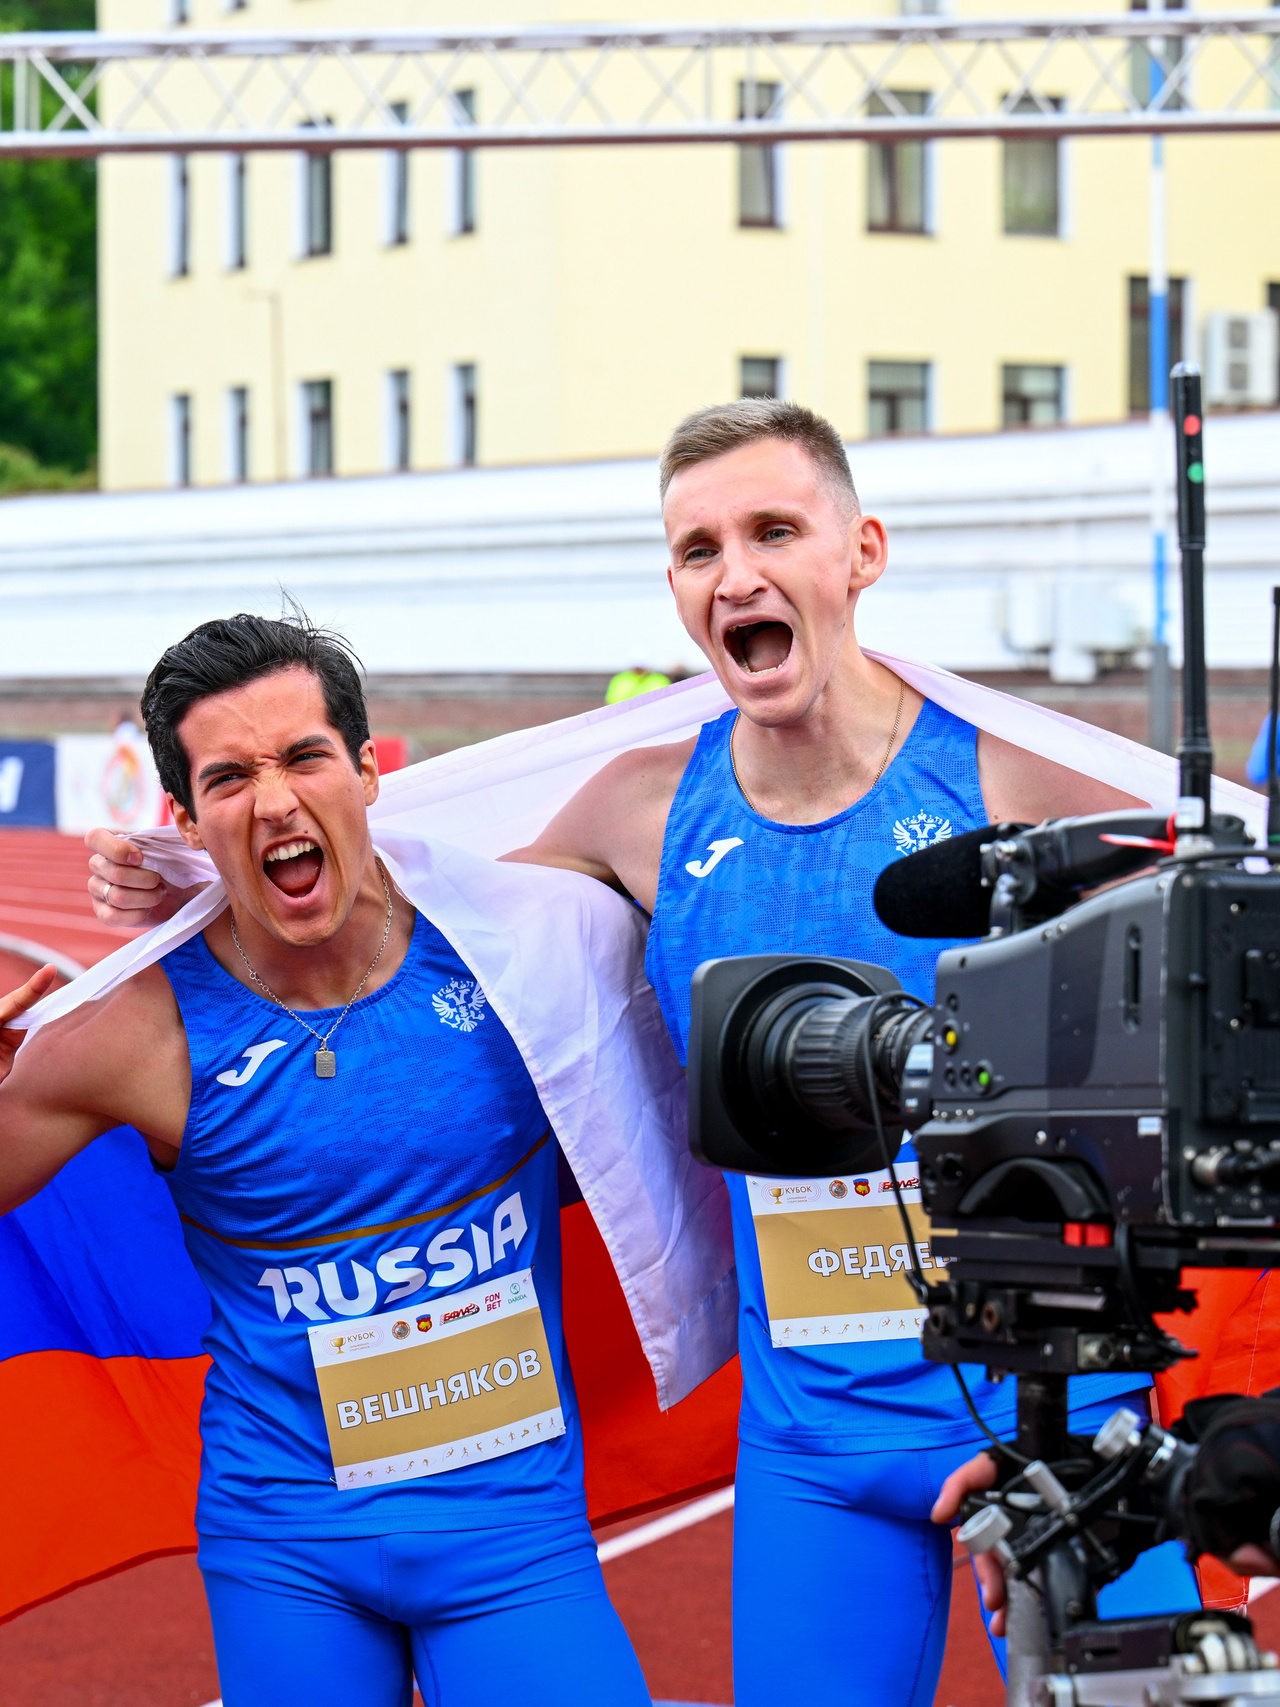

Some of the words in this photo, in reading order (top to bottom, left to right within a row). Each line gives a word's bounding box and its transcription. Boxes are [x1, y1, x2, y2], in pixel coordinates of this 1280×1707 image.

[785, 1186, 812, 1194] КУБОК
[257, 1191, 528, 1323] RUSSIA
[484, 1292, 500, 1304] FON
[486, 1300, 501, 1312] BET
[347, 1331, 375, 1343] КУБОК
[335, 1348, 542, 1430] ВЕШНЯКОВ
